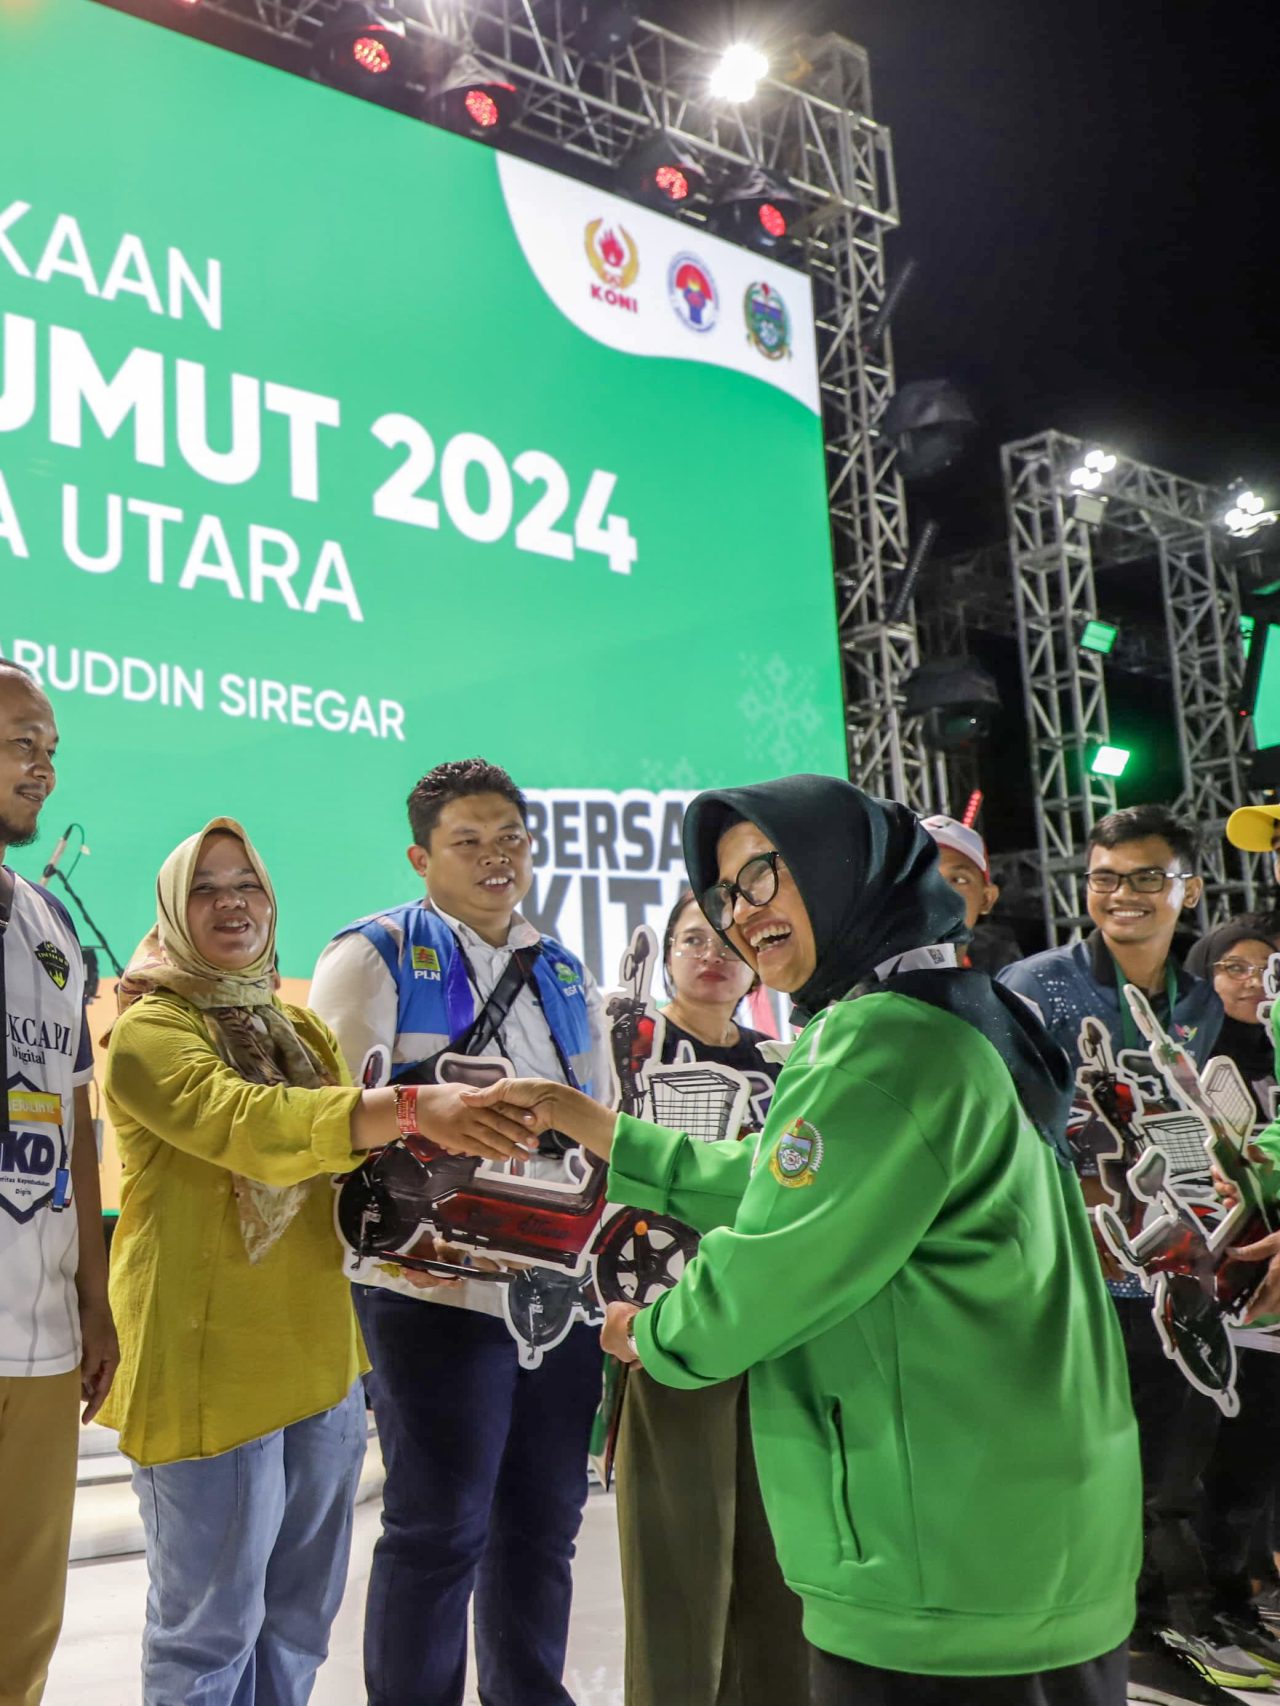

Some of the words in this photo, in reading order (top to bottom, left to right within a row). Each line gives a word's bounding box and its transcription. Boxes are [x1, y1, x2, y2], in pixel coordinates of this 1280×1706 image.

[590, 282, 638, 313] KONI
[370, 412, 638, 575] 2024
[62, 483, 364, 622] UTARA
[219, 673, 406, 741] SIREGAR
[520, 873, 690, 987] KIT
[414, 970, 441, 981] PLN
[12, 1043, 46, 1065] Digital
